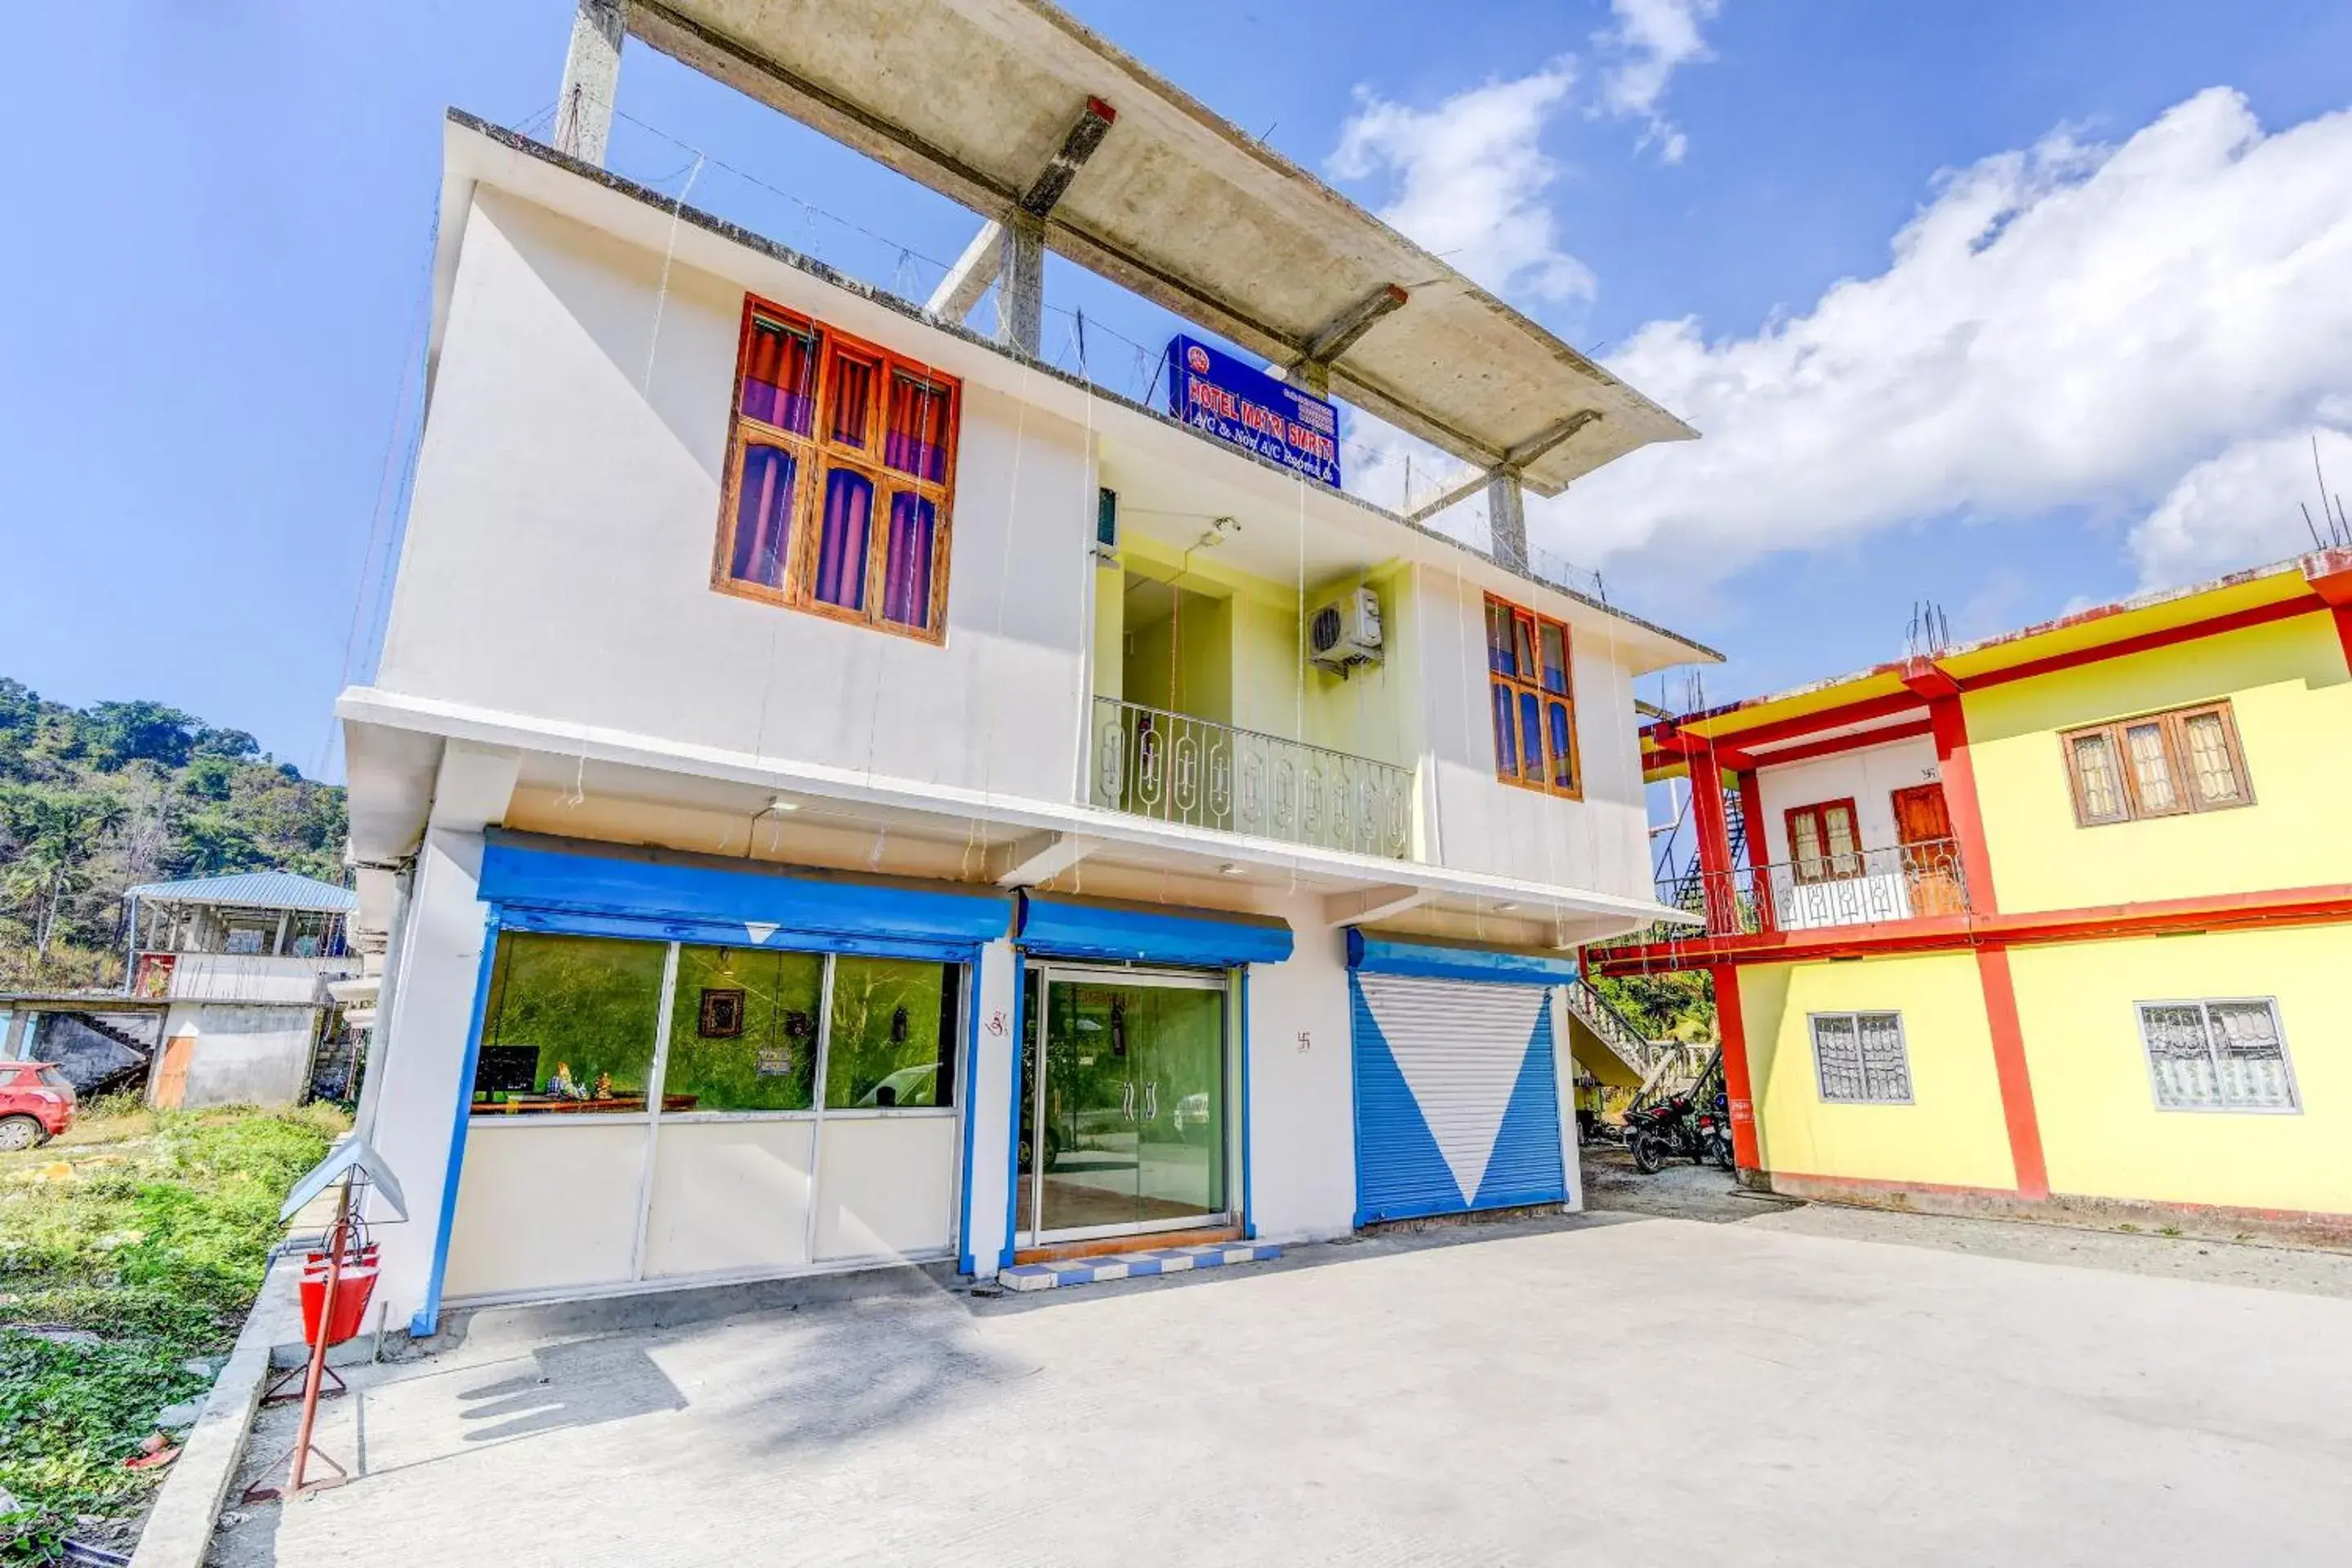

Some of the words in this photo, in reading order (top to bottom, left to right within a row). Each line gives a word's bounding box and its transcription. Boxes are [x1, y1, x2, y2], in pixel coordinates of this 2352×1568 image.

[1189, 378, 1239, 421] HOTEL
[1193, 412, 1215, 434] A/C
[1260, 441, 1281, 458] A/C
